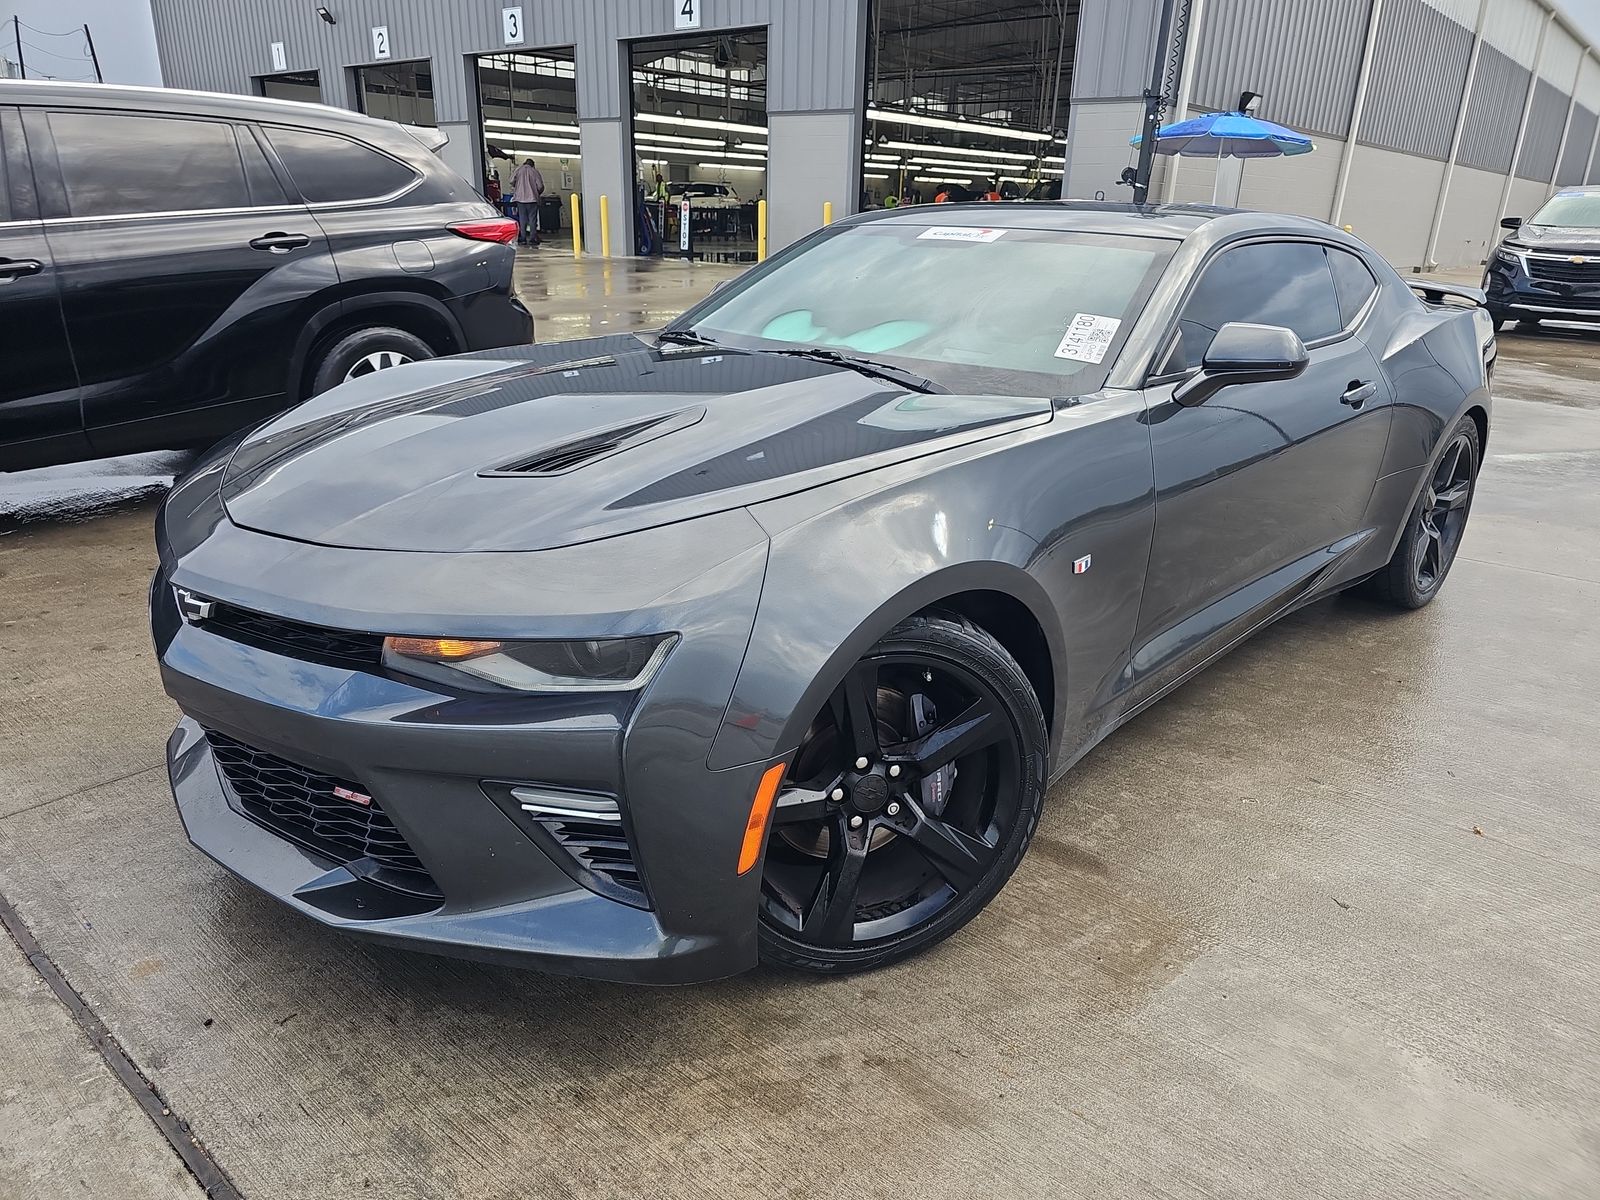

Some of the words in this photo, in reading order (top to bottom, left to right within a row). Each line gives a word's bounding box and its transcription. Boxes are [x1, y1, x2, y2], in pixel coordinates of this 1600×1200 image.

[681, 0, 693, 21] 4
[509, 14, 518, 38] 3
[377, 32, 386, 53] 2
[276, 47, 282, 66] 1
[1061, 315, 1096, 355] 3141180
